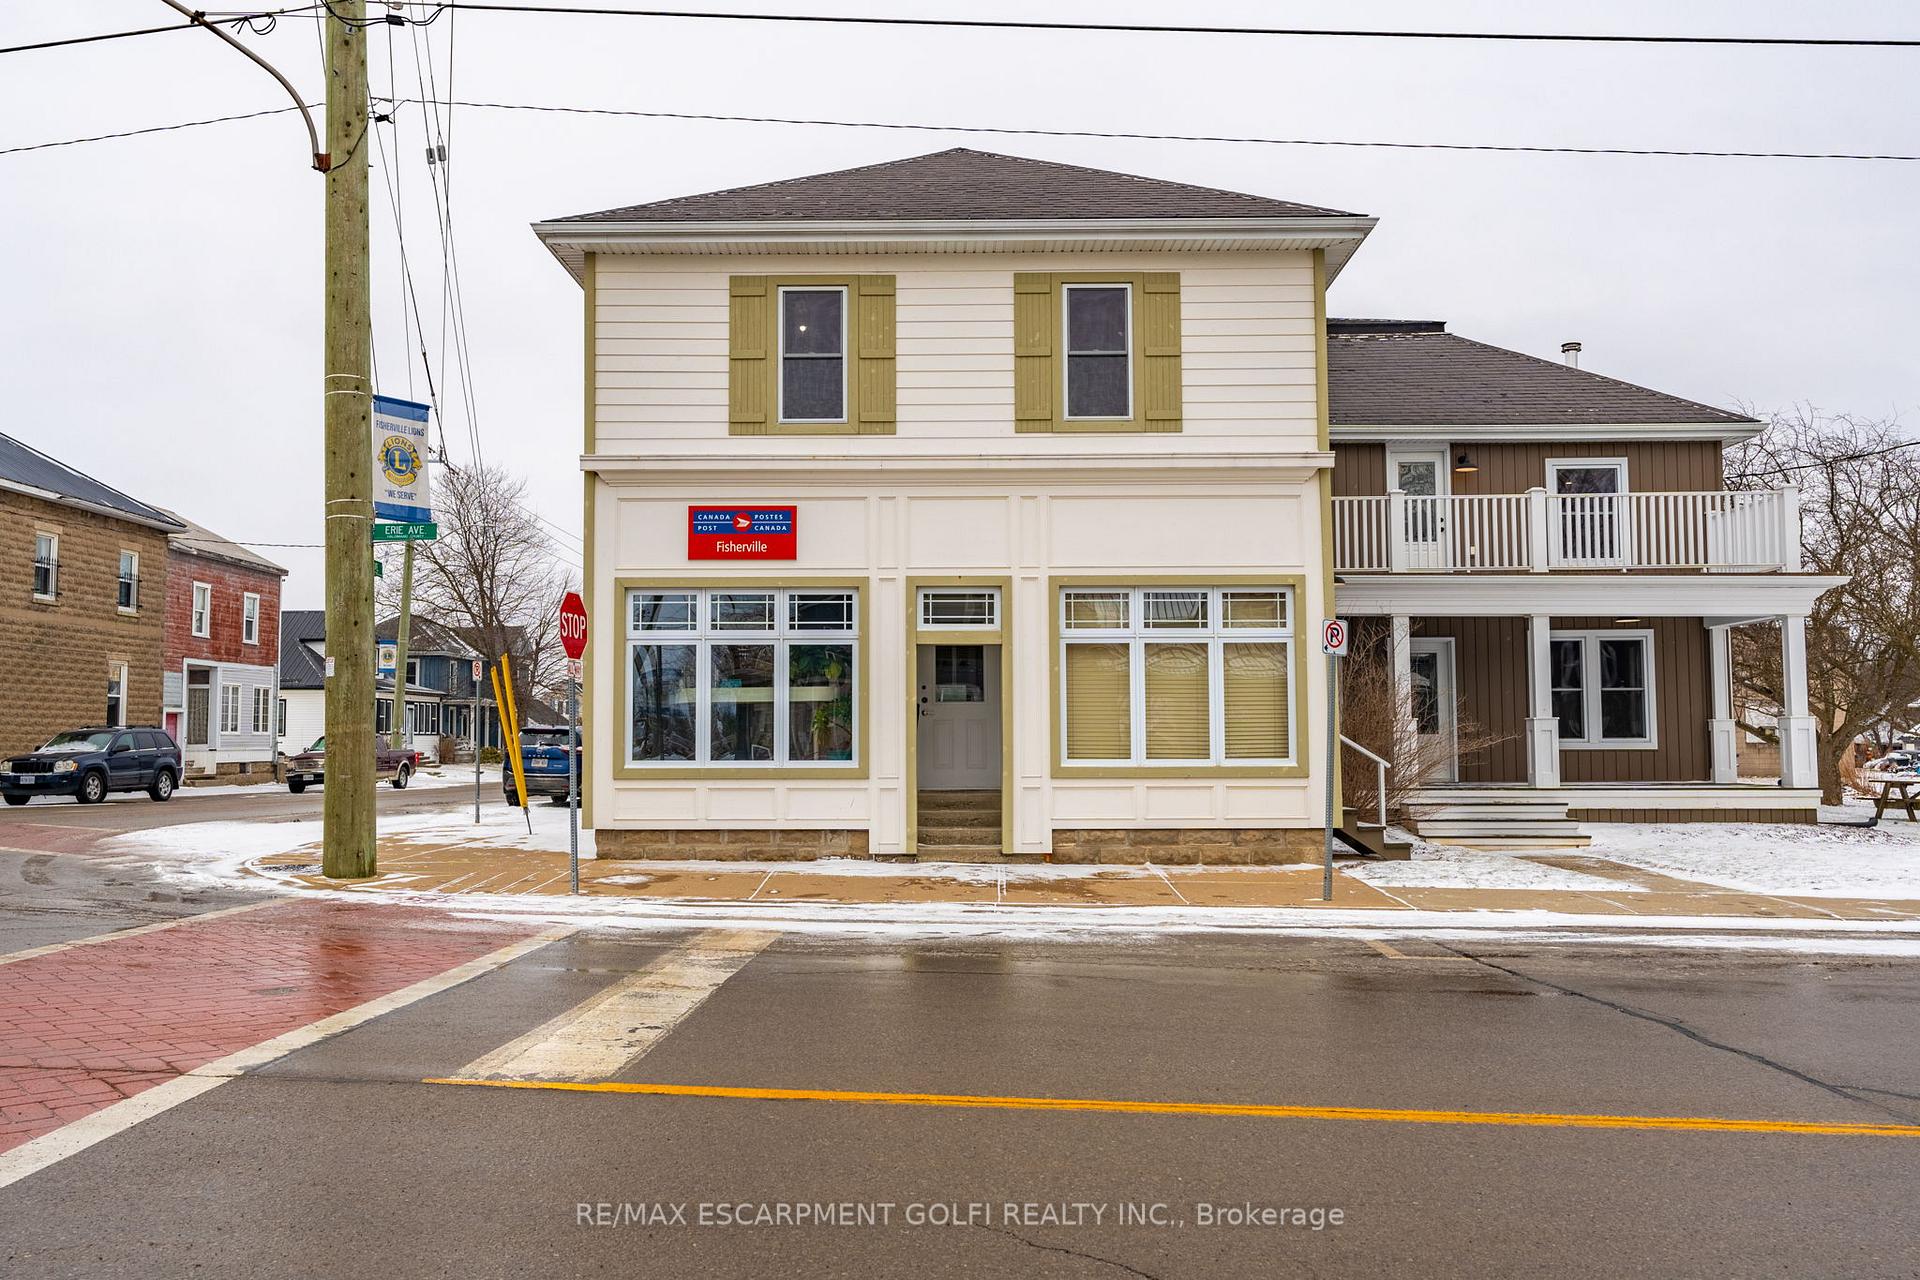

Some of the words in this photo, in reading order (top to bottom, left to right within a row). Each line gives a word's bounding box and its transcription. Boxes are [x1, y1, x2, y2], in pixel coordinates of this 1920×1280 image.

[376, 420, 408, 434] FISHERVILLE
[408, 426, 425, 437] LIONS
[387, 437, 413, 451] LIONS
[394, 450, 406, 470] L
[384, 525, 404, 535] ERIE
[407, 525, 427, 535] AVE.
[716, 540, 768, 553] Fisherville
[561, 612, 586, 640] STOP
